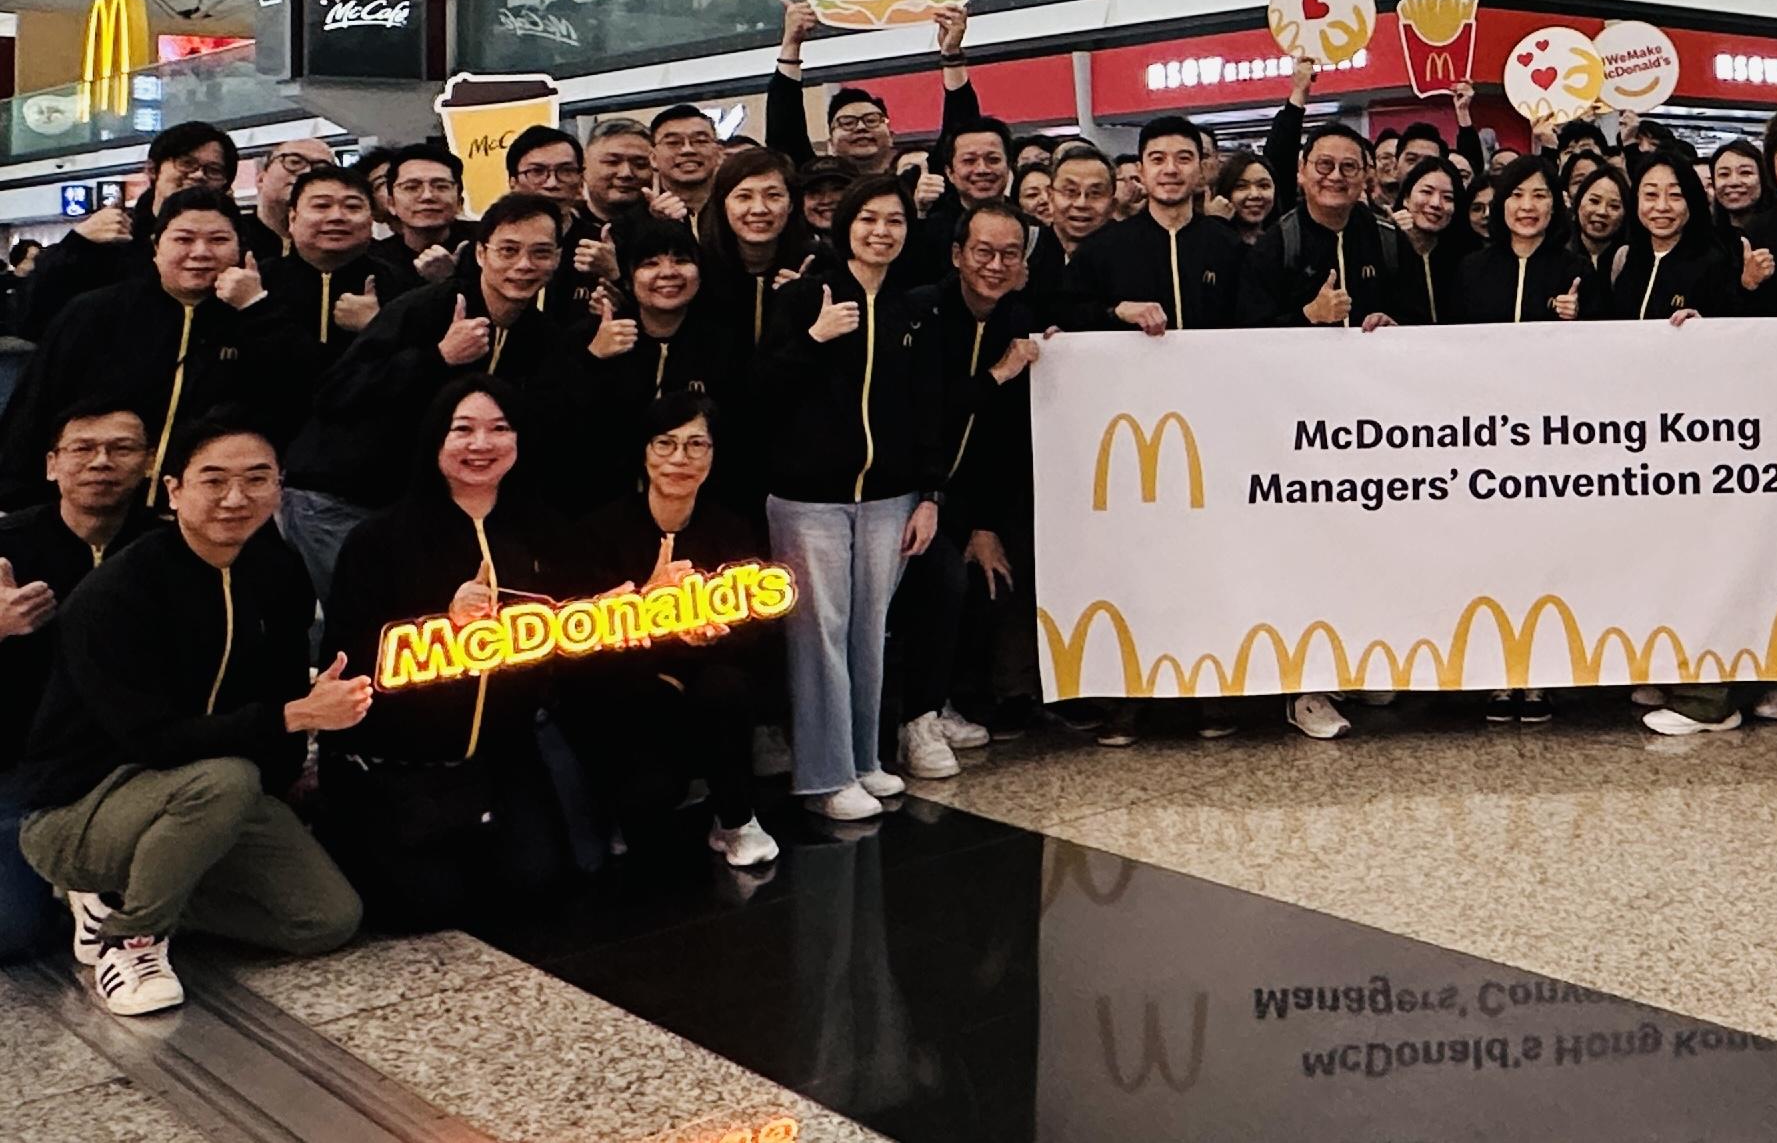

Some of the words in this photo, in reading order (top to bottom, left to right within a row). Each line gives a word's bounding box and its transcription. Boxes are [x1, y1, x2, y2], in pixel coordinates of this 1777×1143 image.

[1601, 44, 1663, 67] WeMake
[1603, 56, 1672, 81] cDonald's
[468, 130, 516, 159] McC
[1295, 415, 1531, 453] McDonald’s
[1543, 416, 1648, 454] Hong
[1660, 412, 1762, 451] Kong
[1248, 467, 1460, 512] Managers’
[1468, 463, 1702, 501] Convention
[376, 562, 797, 690] McDonald's
